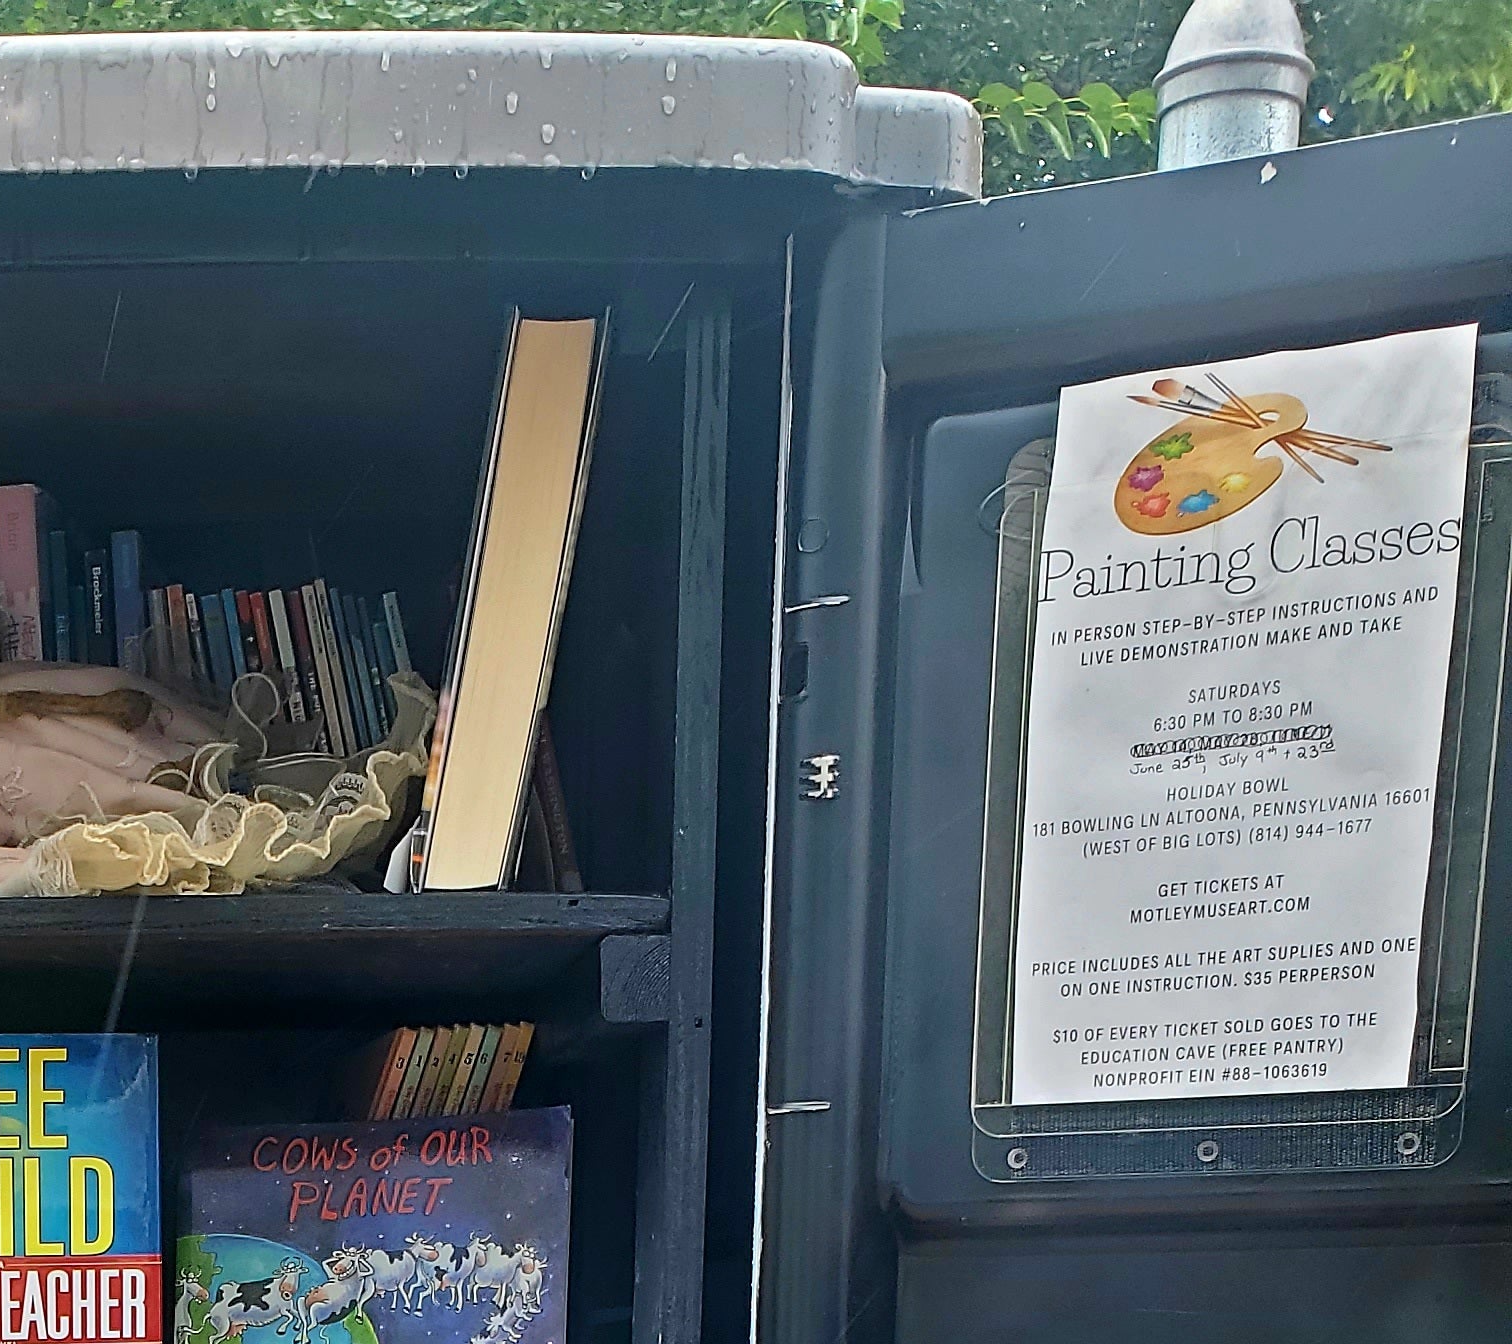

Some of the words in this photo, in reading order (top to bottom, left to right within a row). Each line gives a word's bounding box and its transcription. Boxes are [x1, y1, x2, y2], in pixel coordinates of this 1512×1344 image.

[1038, 543, 1256, 602] Painting
[1270, 514, 1462, 574] Classes
[1051, 632, 1068, 646] IN
[1073, 623, 1136, 644] PERSON
[1143, 607, 1266, 635] STEP-BY-STEP
[1271, 591, 1396, 620] INSTRUCTIONS
[1401, 586, 1438, 604] AND
[1080, 651, 1115, 666] LIVE
[1120, 632, 1259, 663] DEMONSTRATION
[1265, 626, 1311, 646] MAKE
[1317, 620, 1354, 640] AND
[1359, 615, 1402, 634] TAKE
[1188, 679, 1282, 705] SATURDAYS
[1153, 716, 1187, 732] 6:30
[1192, 712, 1216, 728] PM
[1222, 708, 1244, 724] TO
[1248, 704, 1283, 721] 8:30
[1289, 701, 1313, 718] PM
[1129, 761, 1163, 776] June
[1218, 753, 1248, 770] July
[1255, 746, 1278, 762] 9th
[1297, 740, 1336, 759] 23rd
[1166, 782, 1237, 802] HOLIDAY
[1242, 777, 1288, 796] BOWL
[1033, 821, 1056, 838] 181
[1061, 814, 1135, 836] BOWLING
[1140, 810, 1161, 827] LN
[1165, 804, 1246, 826] ALTOONA,
[1253, 793, 1379, 818] PENNSYLVANIA
[1384, 787, 1430, 807] 16601
[1083, 839, 1131, 859] (WEST
[1136, 836, 1158, 852] OF
[1162, 833, 1191, 850] BIG
[1196, 829, 1242, 848] LOTS)
[1248, 825, 1288, 845] (814)
[1294, 818, 1372, 840] 944-1677
[1158, 881, 1189, 898] GET
[1194, 876, 1260, 895] TICKETS
[1264, 874, 1285, 890] AT
[1129, 896, 1311, 924] MOTLEYMUSEART.COM
[1032, 959, 1077, 977] PRICE
[1082, 953, 1159, 974] INCLUDES
[1164, 952, 1192, 969] ALL
[1197, 949, 1227, 966] THE
[1232, 947, 1263, 963] ART
[1268, 942, 1334, 962] SUPLIES
[1340, 939, 1376, 956] AND
[1381, 937, 1416, 953] ONE
[1060, 982, 1083, 998] ON
[1088, 978, 1121, 996] ONE
[1126, 970, 1239, 994] INSTRUCTION.
[1243, 969, 1273, 988] $35
[1278, 963, 1376, 985] PERPERSON
[1053, 1027, 1078, 1045] $10
[1084, 1025, 1105, 1042] OF
[1110, 1021, 1158, 1042] EVERY
[1163, 1020, 1219, 1038] TICKET
[1223, 1017, 1264, 1035] SOLD
[1270, 1014, 1315, 1032] GOES
[1320, 1013, 1341, 1029] TO
[1346, 1011, 1377, 1028] THE
[395, 1057, 406, 1070] 3
[415, 1055, 423, 1068] 1
[463, 1052, 474, 1065] 5
[480, 1052, 488, 1064] 6
[503, 1052, 512, 1063] 7
[1081, 1046, 1169, 1066] EDUCATION
[1175, 1042, 1217, 1062] CAVE
[1222, 1040, 1267, 1061] (FREE
[1273, 1036, 1345, 1057] PANTRY)
[1093, 1069, 1183, 1088] NONPROFIT
[1188, 1066, 1214, 1084] EIN
[1221, 1061, 1328, 1082] #88-1063619
[253, 1134, 359, 1176] COWS
[370, 1133, 411, 1172] of
[420, 1126, 494, 1169] OUR
[289, 1176, 453, 1223] PLANET
